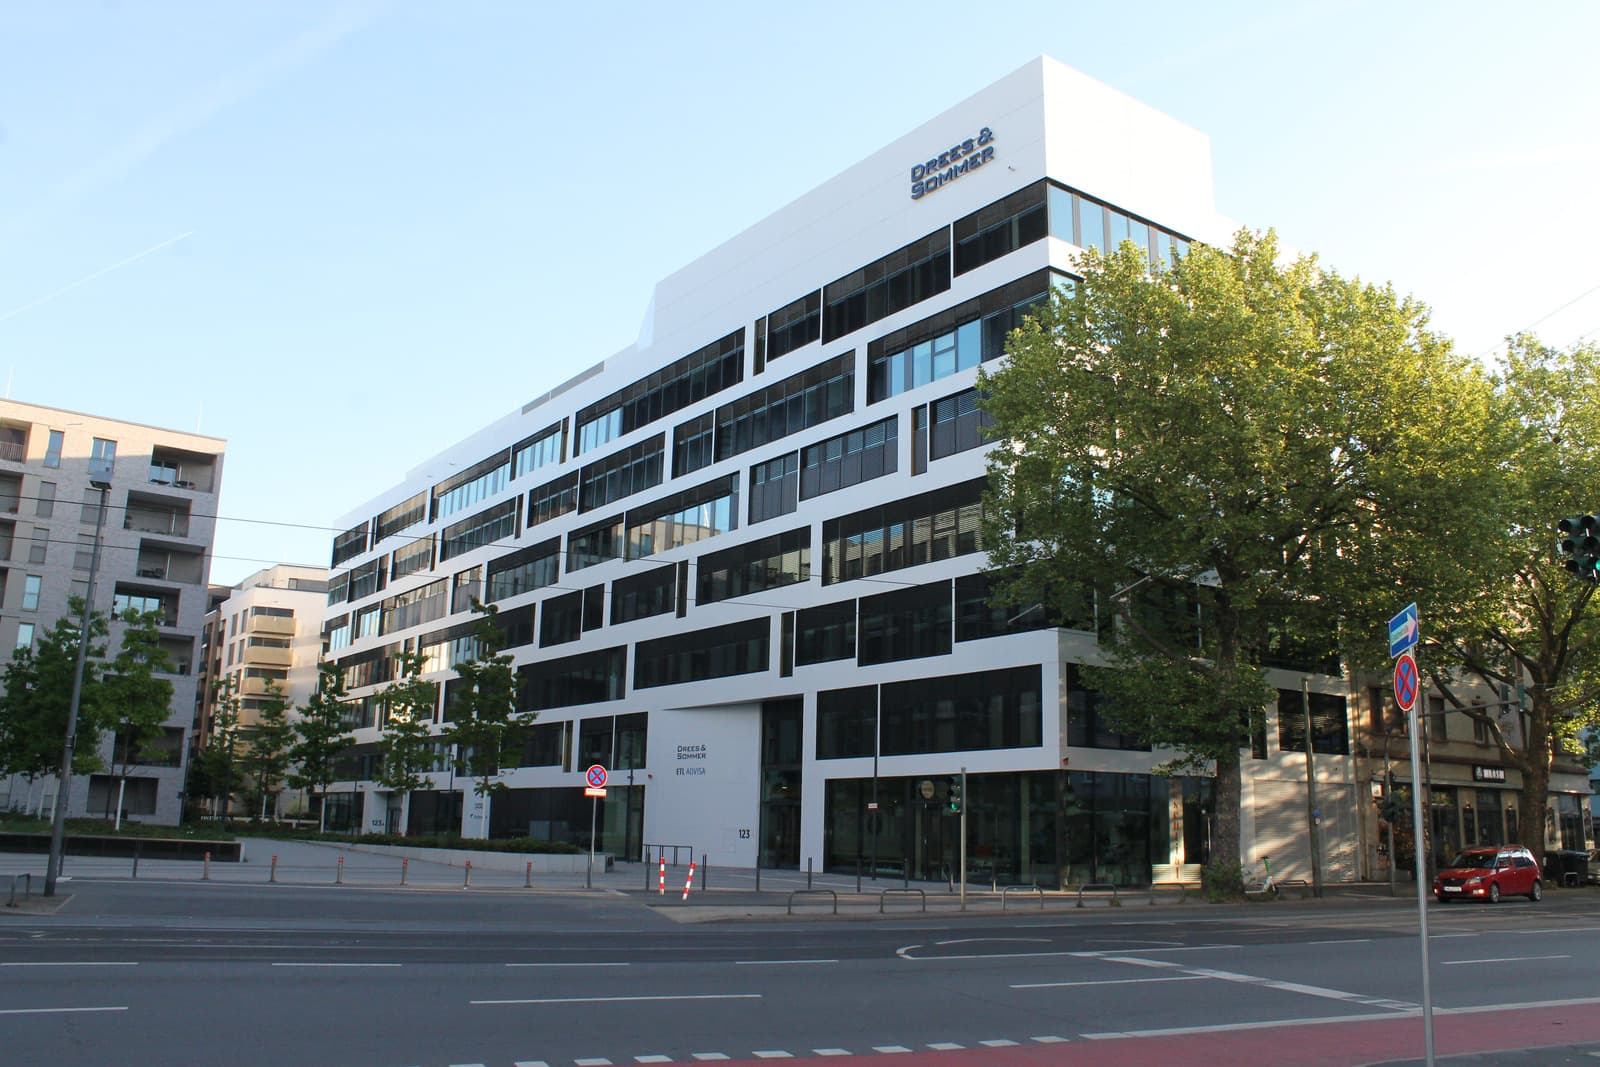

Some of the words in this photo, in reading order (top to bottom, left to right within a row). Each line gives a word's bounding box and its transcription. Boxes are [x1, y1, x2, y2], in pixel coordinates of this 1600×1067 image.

[911, 138, 974, 182] DREES
[977, 126, 994, 146] &
[911, 145, 994, 200] SOMMER
[677, 745, 700, 753] DREES
[700, 744, 706, 752] &
[738, 829, 751, 839] 123
